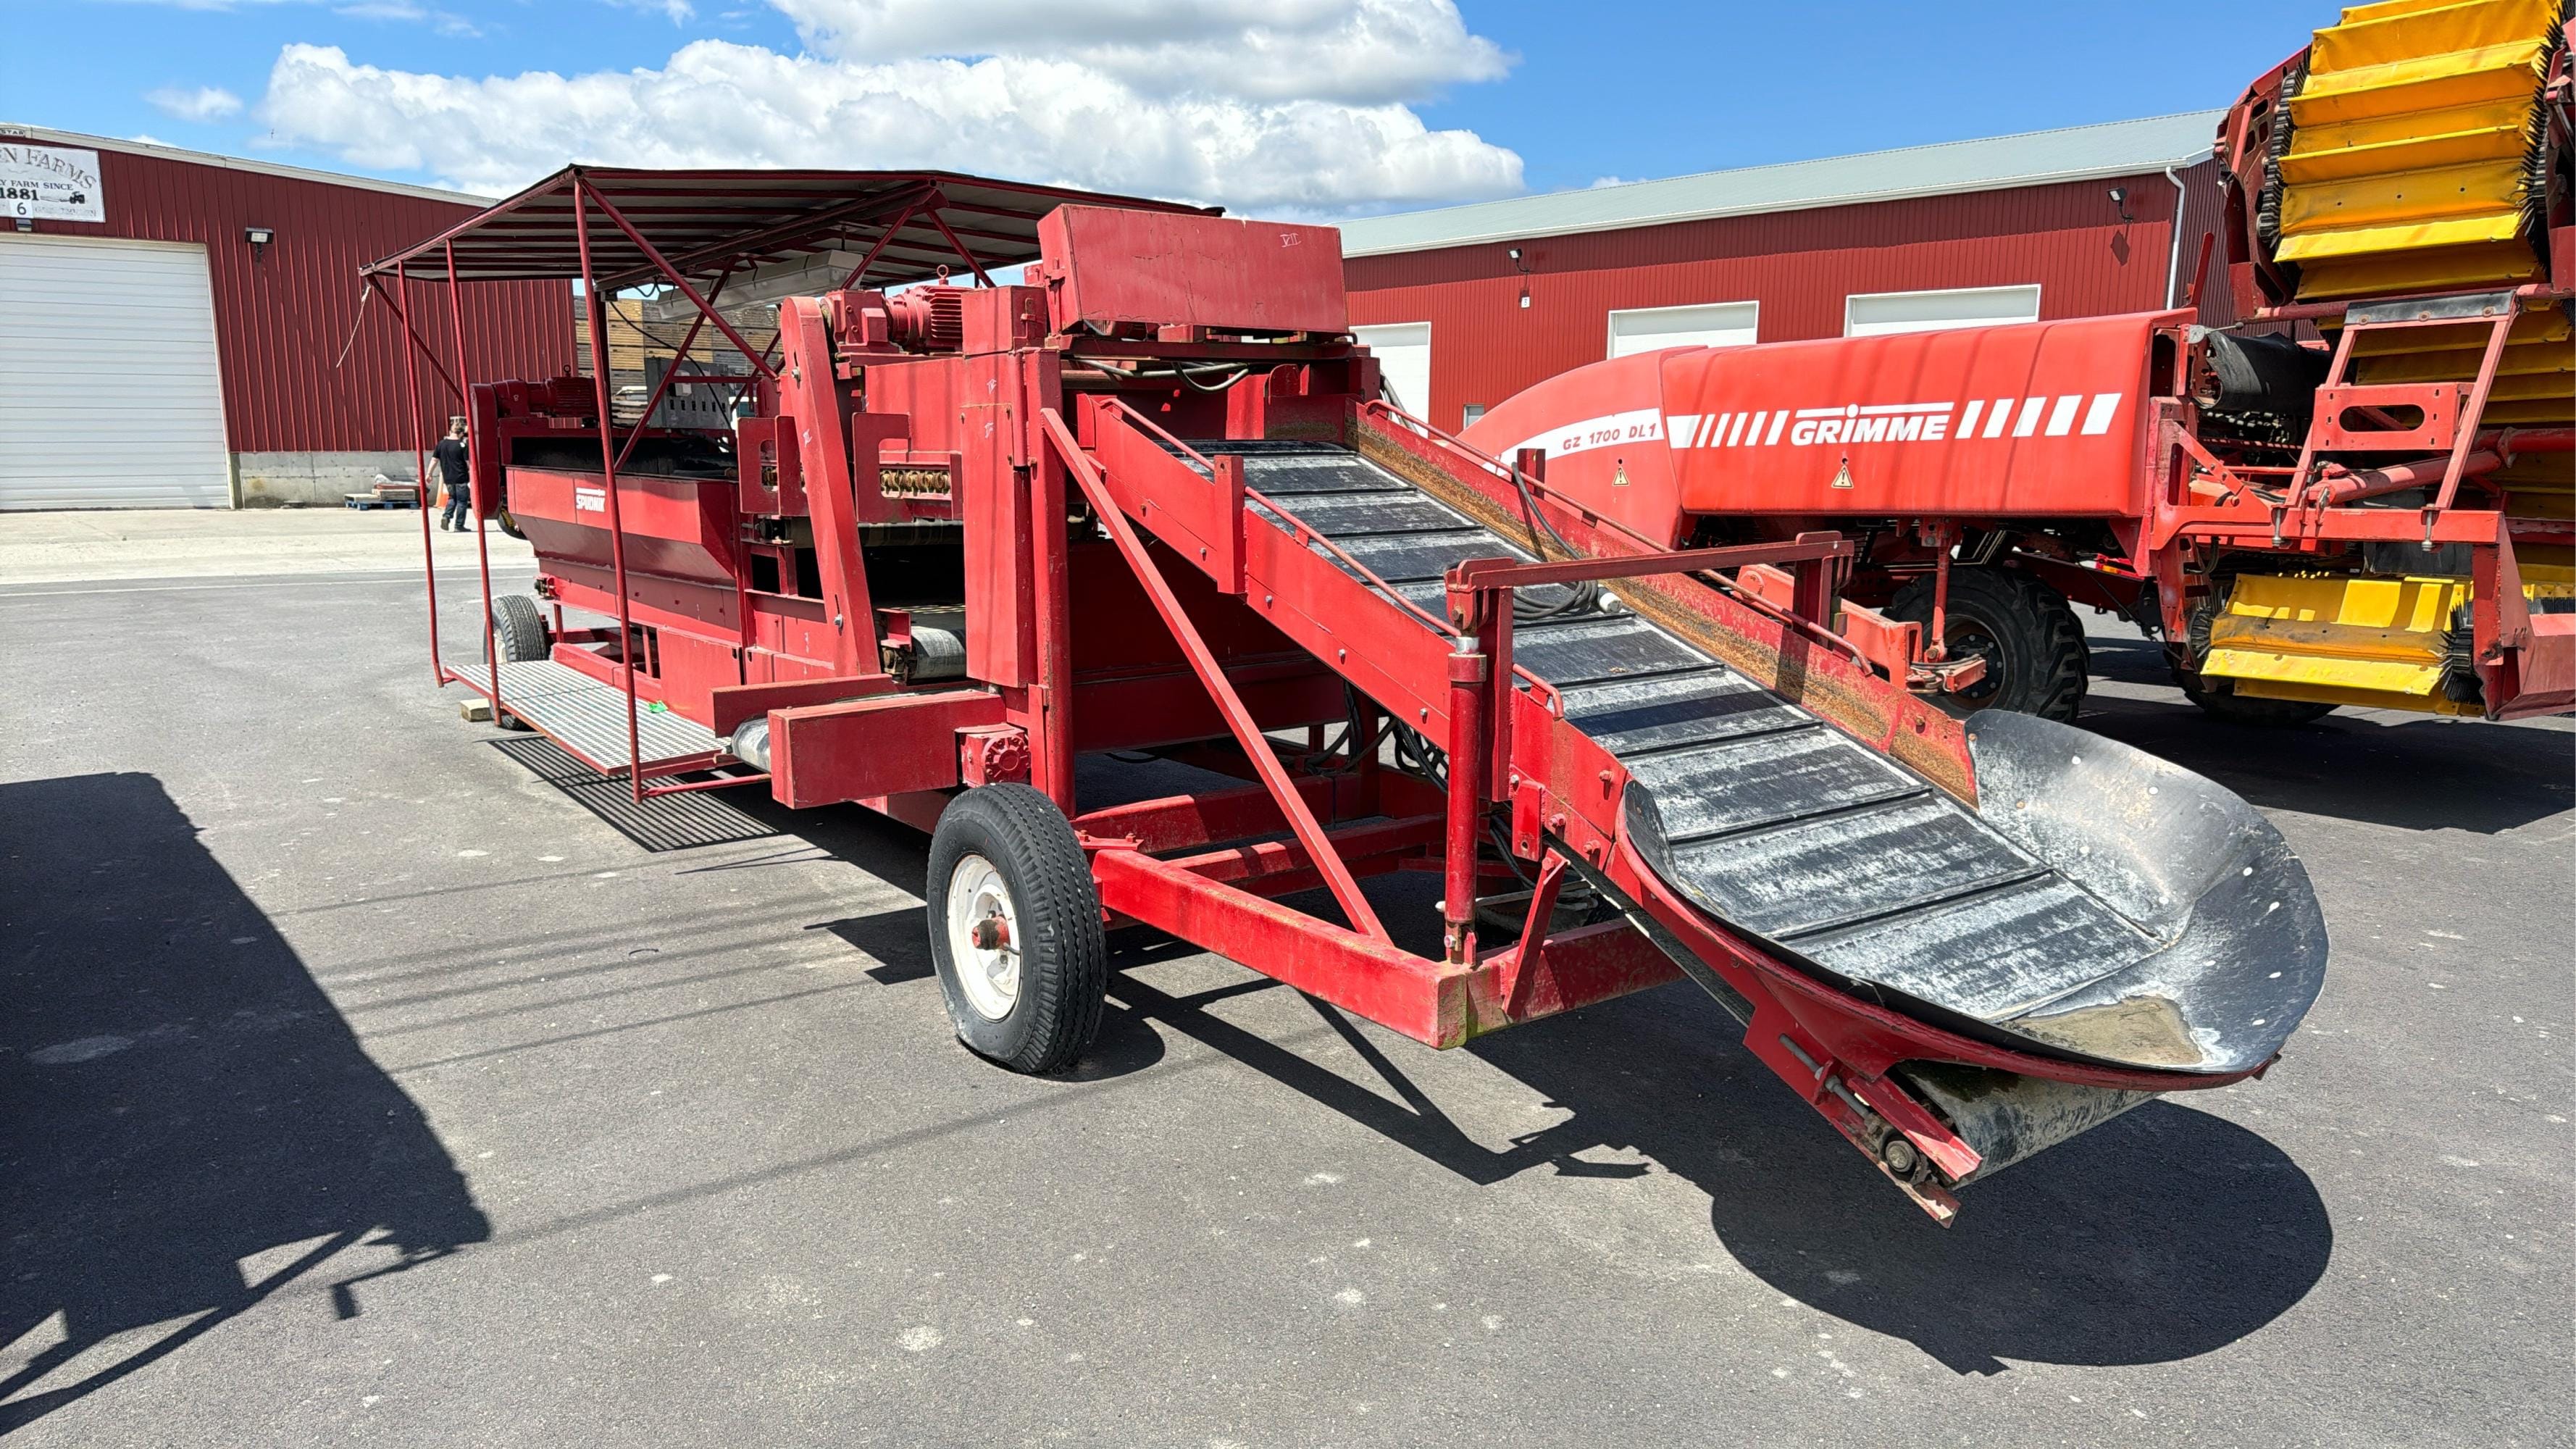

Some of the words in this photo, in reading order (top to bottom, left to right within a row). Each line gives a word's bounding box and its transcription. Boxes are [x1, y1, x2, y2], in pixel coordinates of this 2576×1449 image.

[25, 147, 96, 189] FARMS
[11, 180, 39, 188] FARM
[43, 182, 74, 191] SINCE
[0, 187, 39, 201] 1881
[17, 202, 27, 215] 6
[1563, 436, 1581, 451] GZ
[1589, 428, 1621, 445] 1700
